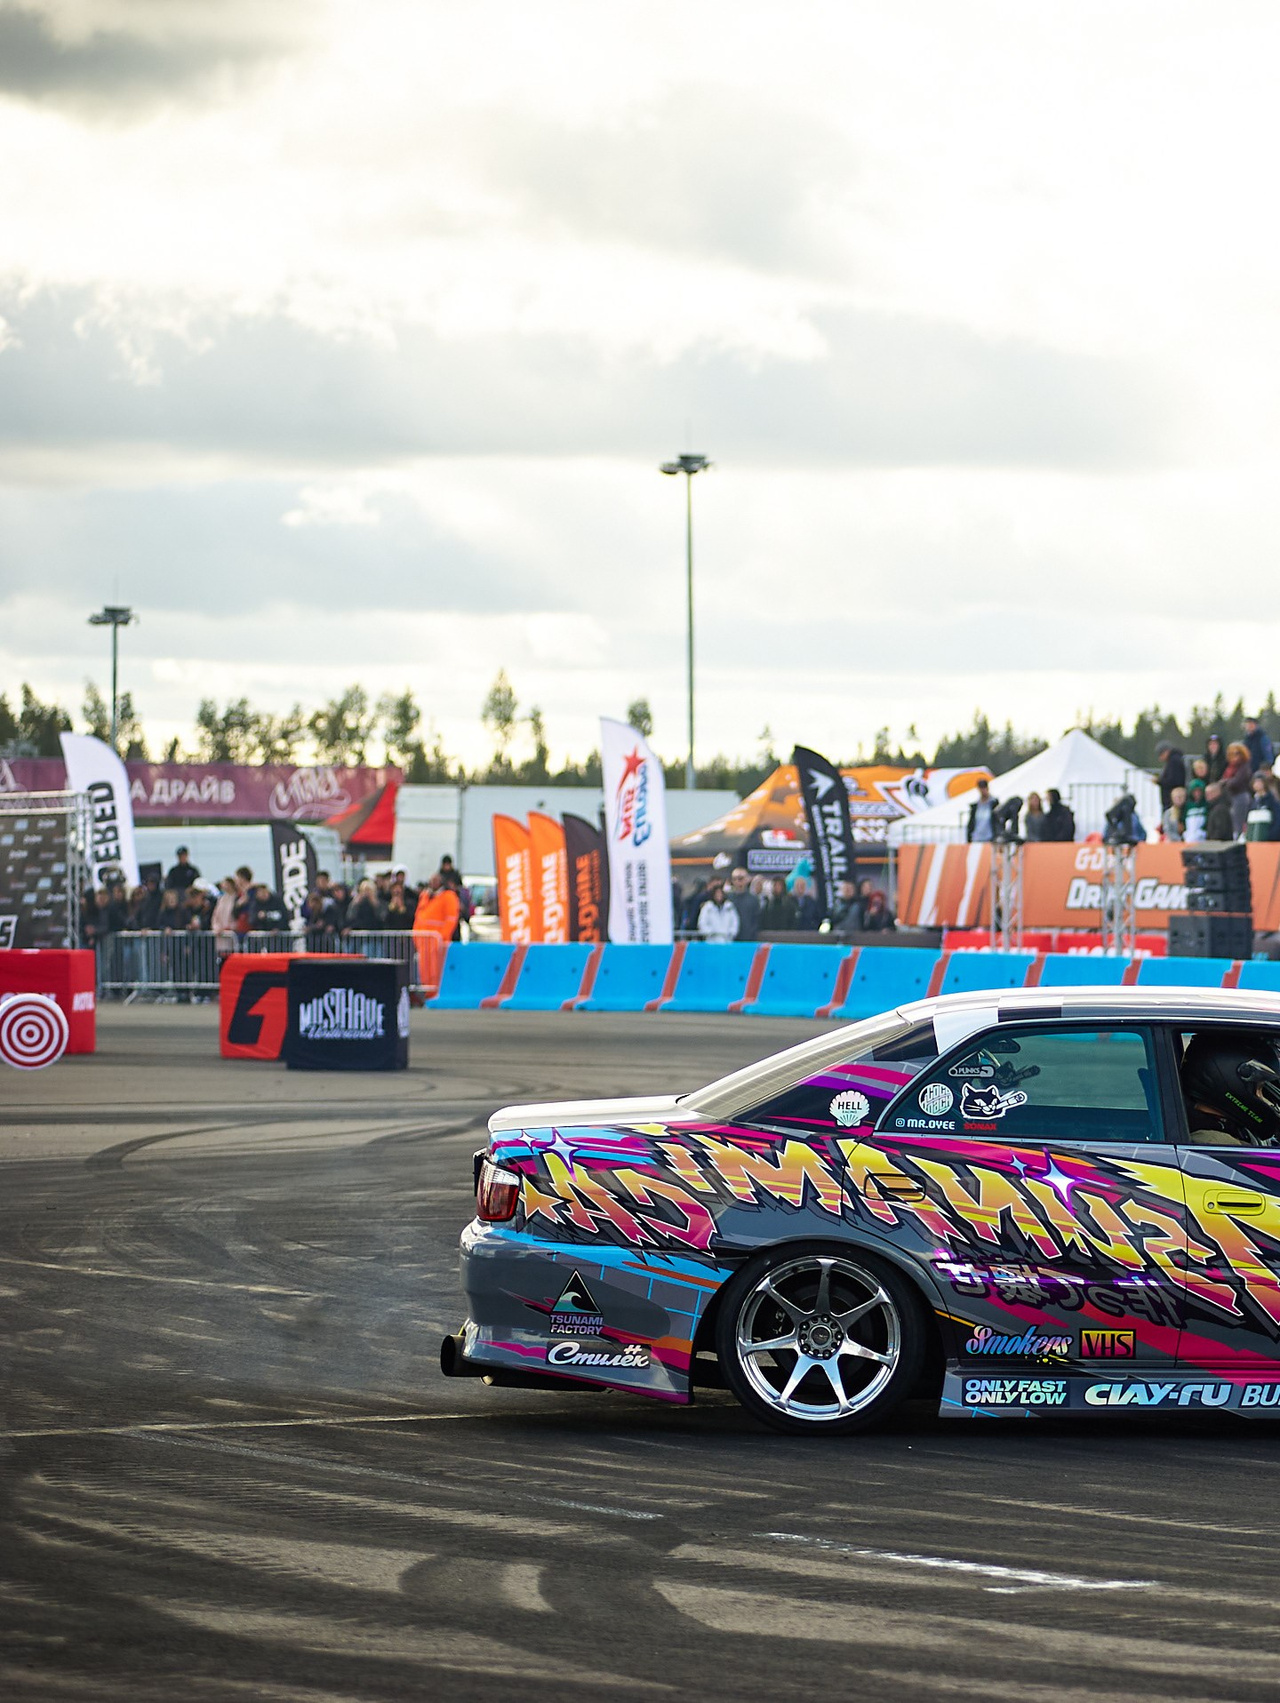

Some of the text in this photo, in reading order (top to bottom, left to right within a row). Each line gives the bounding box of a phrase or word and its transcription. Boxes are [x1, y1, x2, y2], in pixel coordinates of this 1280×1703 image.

[151, 775, 236, 806] ДРАЙВ
[1134, 878, 1192, 909] GAM
[838, 1101, 862, 1110] HELL
[550, 1314, 604, 1325] TSUNAMI
[550, 1324, 603, 1335] FACTORY
[966, 1325, 1074, 1356] Smokers
[1084, 1333, 1131, 1357] VHS
[965, 1380, 1067, 1392] ONLY FAST
[965, 1391, 1067, 1405] ONLY LOW
